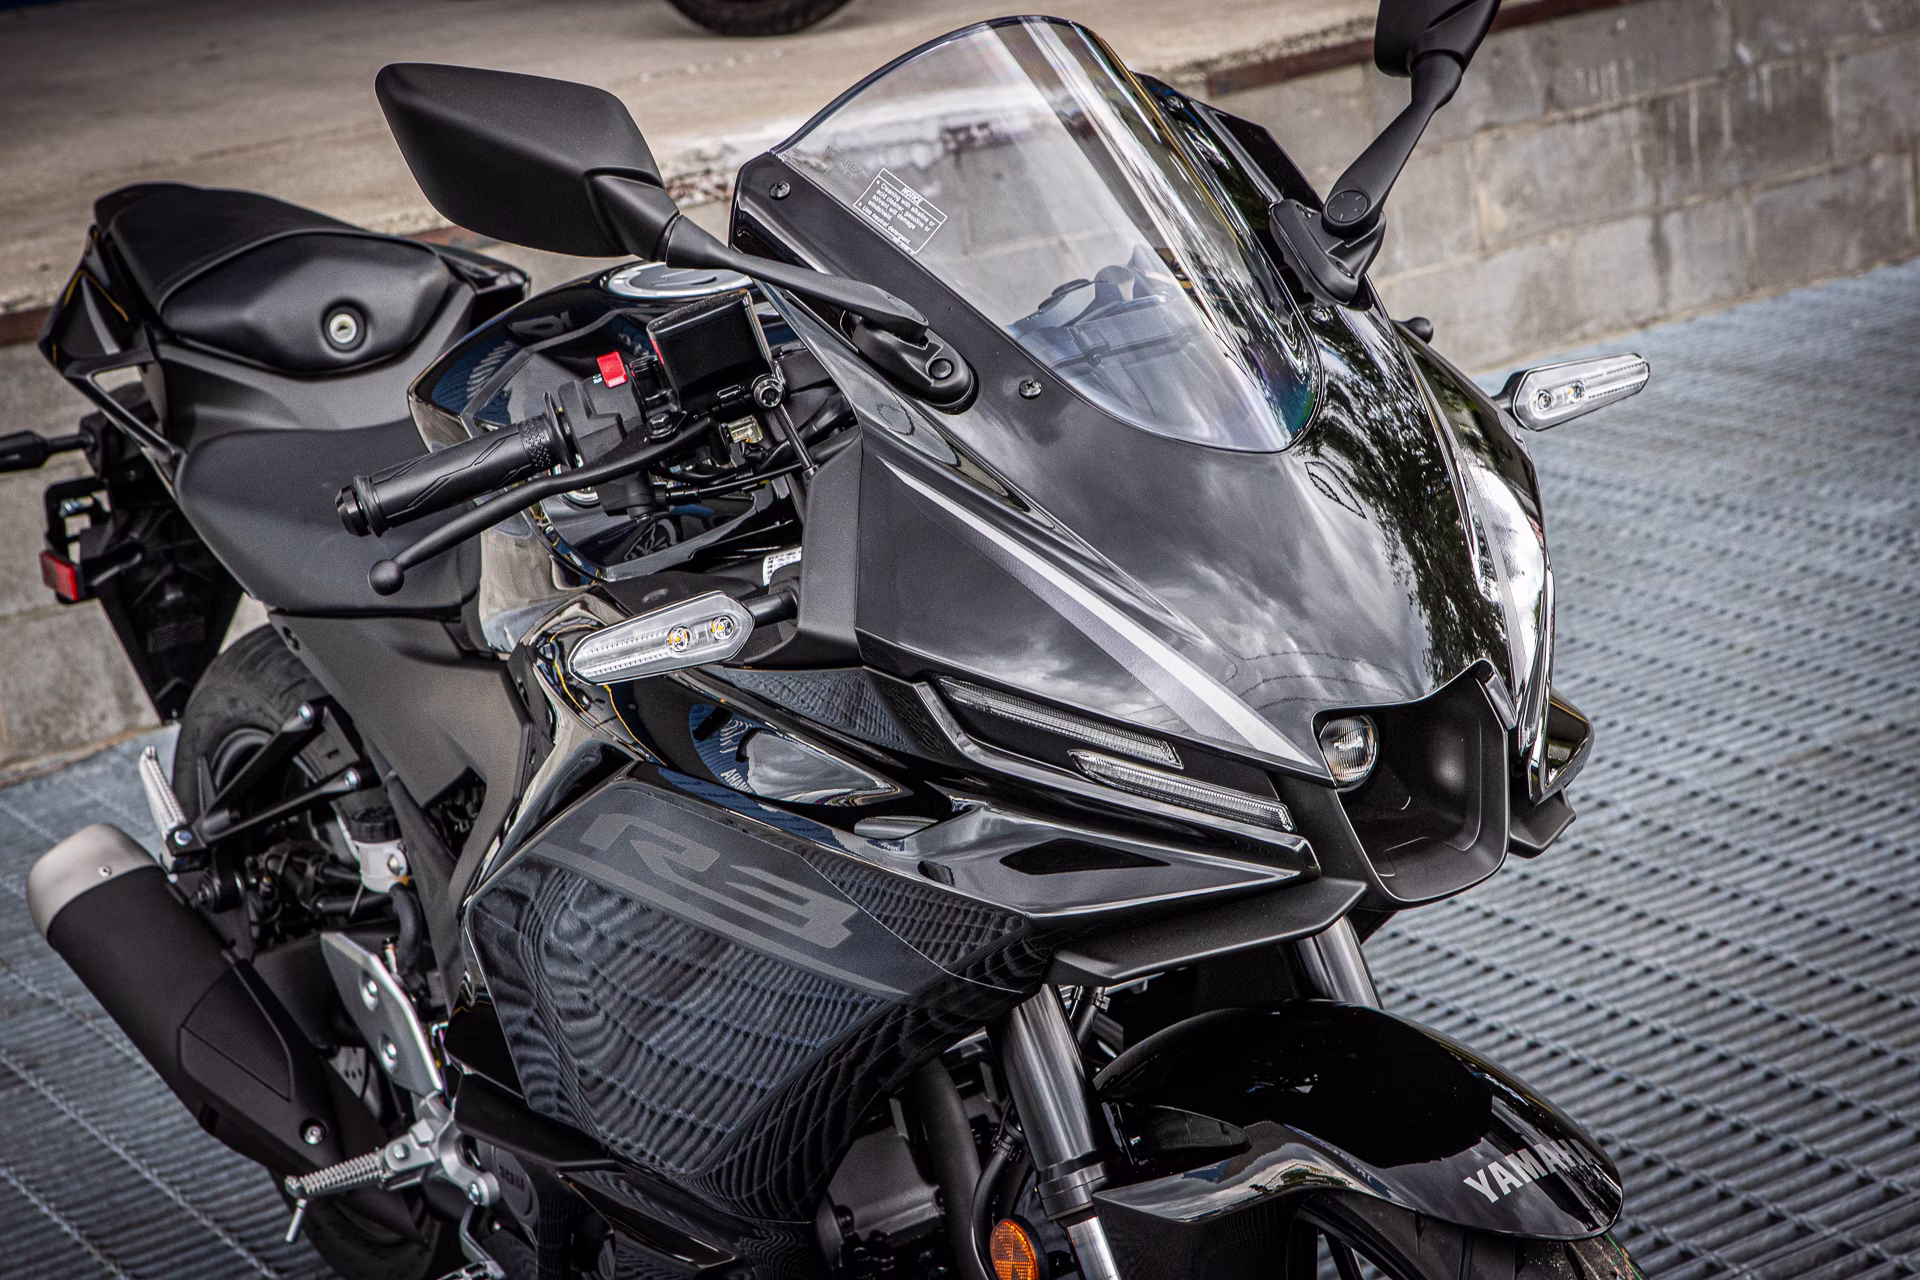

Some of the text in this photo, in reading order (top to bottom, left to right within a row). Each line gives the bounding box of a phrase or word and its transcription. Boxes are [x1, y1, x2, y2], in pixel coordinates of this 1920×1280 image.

[825, 145, 862, 175] NOVAREX
[872, 194, 915, 229] solvent will damage
[876, 189, 887, 199] acid
[904, 211, 924, 228] gasoline
[881, 183, 901, 202] Cleaning
[901, 199, 911, 208] with
[911, 206, 929, 222] alkaline
[901, 187, 923, 205] NOTICE
[862, 205, 872, 215] Use
[872, 213, 889, 227] neutral
[580, 813, 859, 948] R3
[1463, 1138, 1603, 1203] YAMAHA
